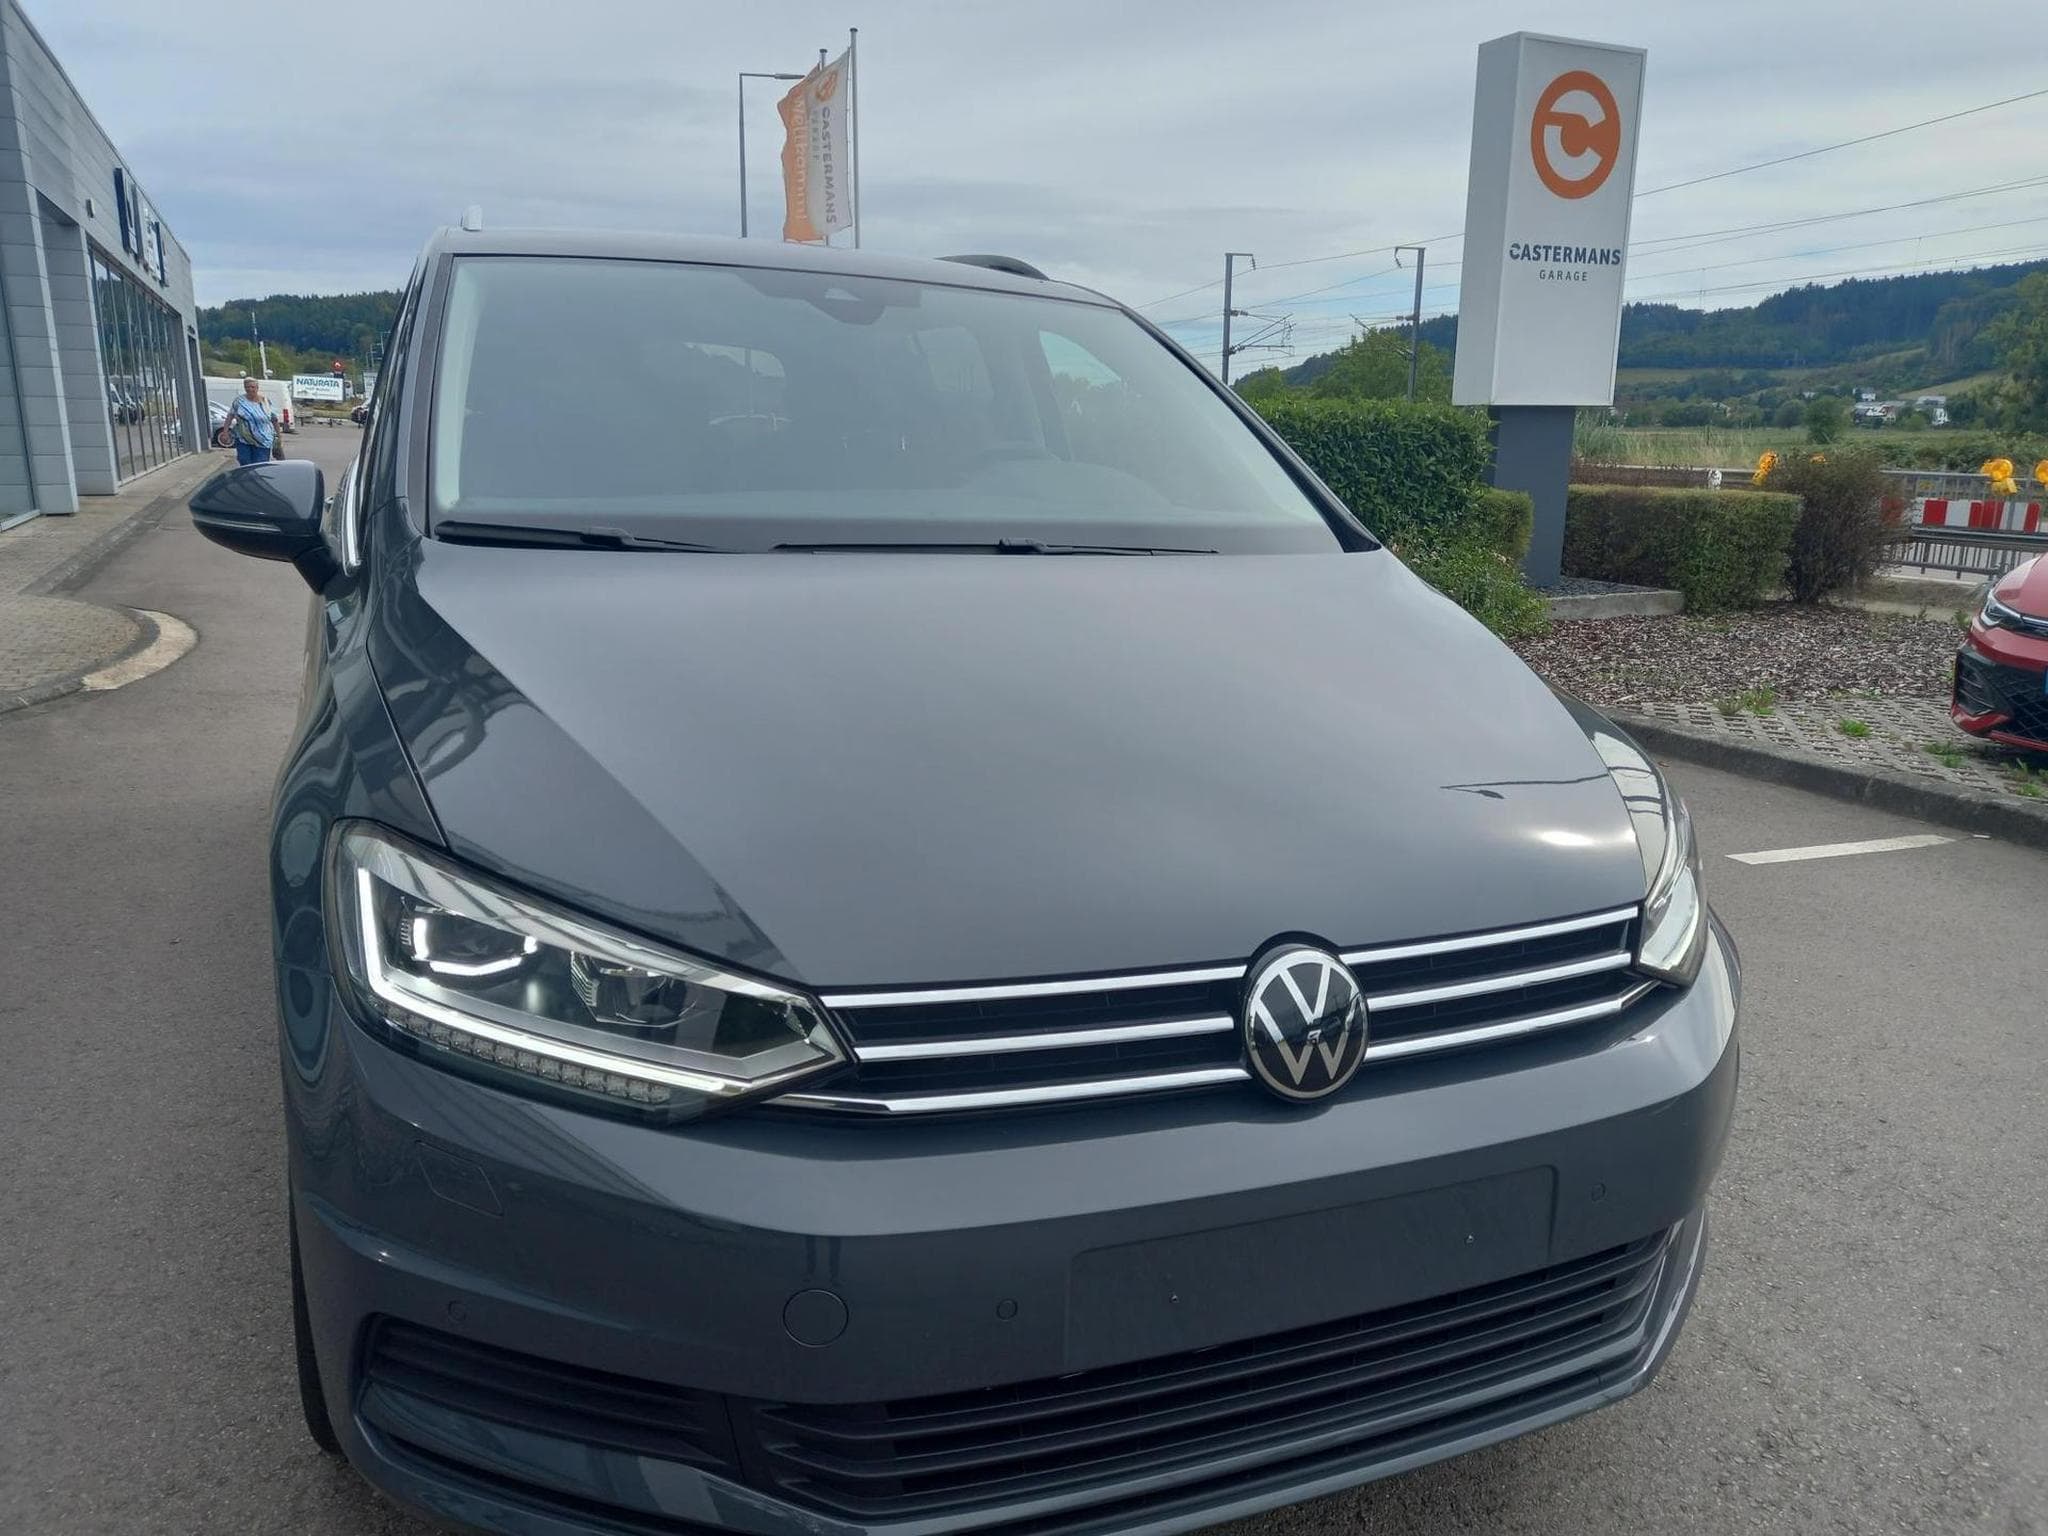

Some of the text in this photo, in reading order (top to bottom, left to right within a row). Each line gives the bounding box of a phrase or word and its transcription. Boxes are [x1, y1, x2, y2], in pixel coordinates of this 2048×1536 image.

[821, 106, 837, 224] CASTERMANS
[1509, 242, 1622, 265] CASTERMANS
[1539, 269, 1588, 281] GARAGE
[296, 378, 340, 388] NATURATA
